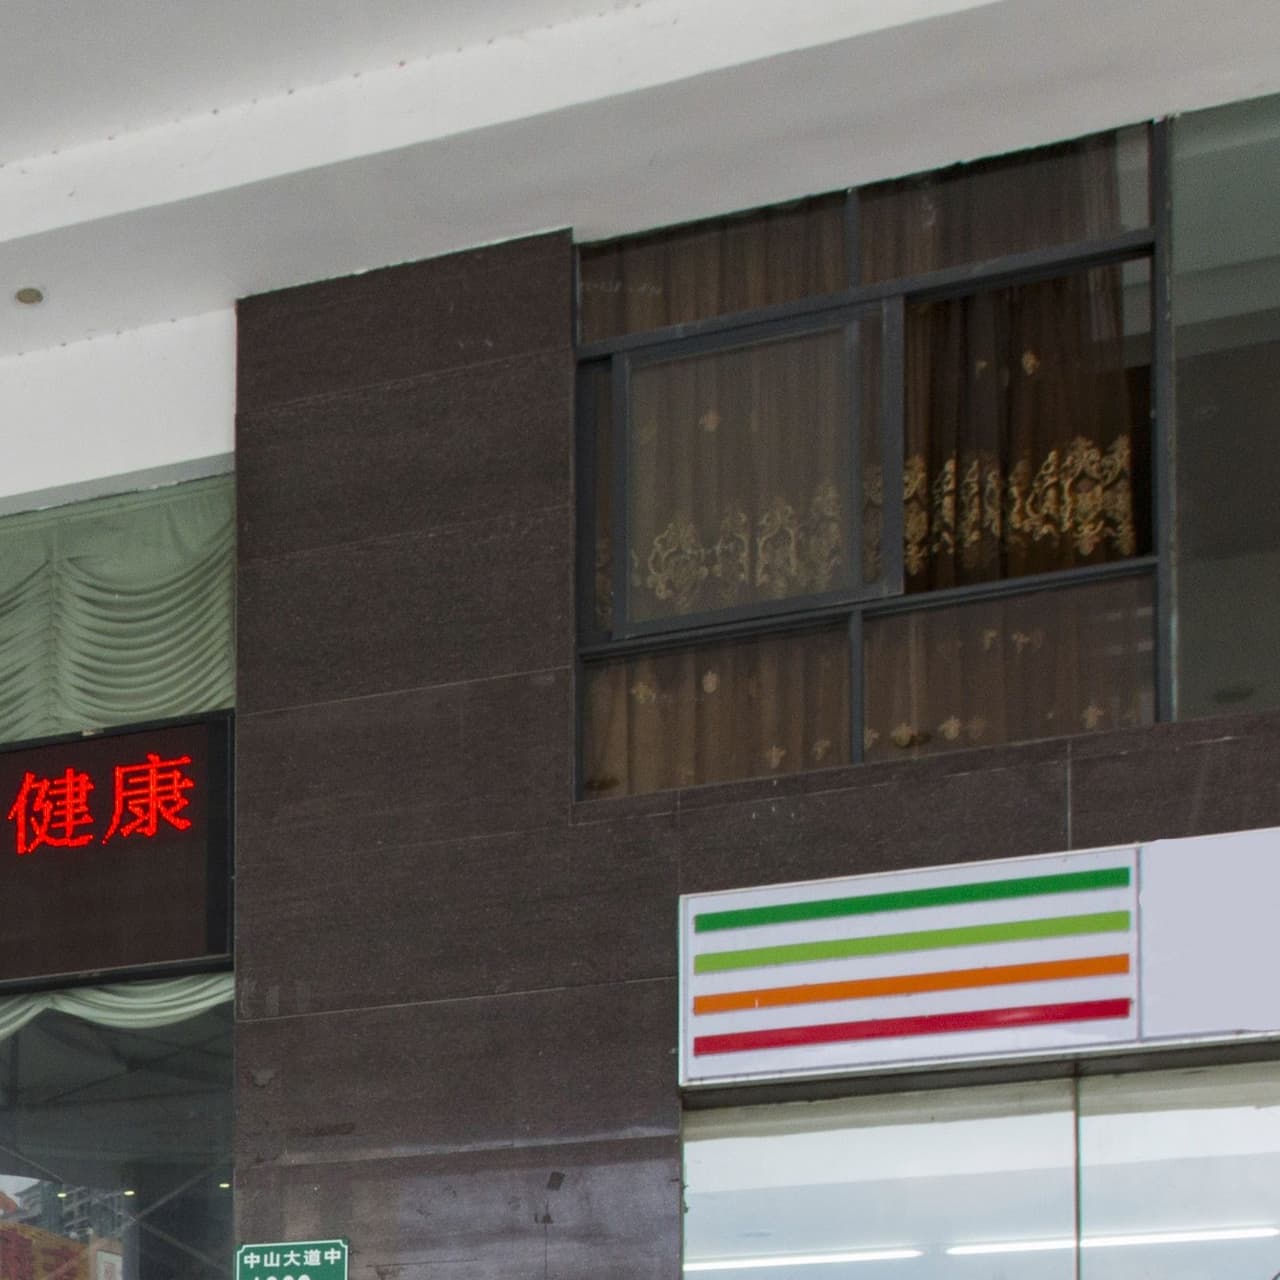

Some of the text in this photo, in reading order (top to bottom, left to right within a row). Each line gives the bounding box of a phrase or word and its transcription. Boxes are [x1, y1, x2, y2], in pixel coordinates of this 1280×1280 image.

[243, 1247, 342, 1269] 中山大道中
